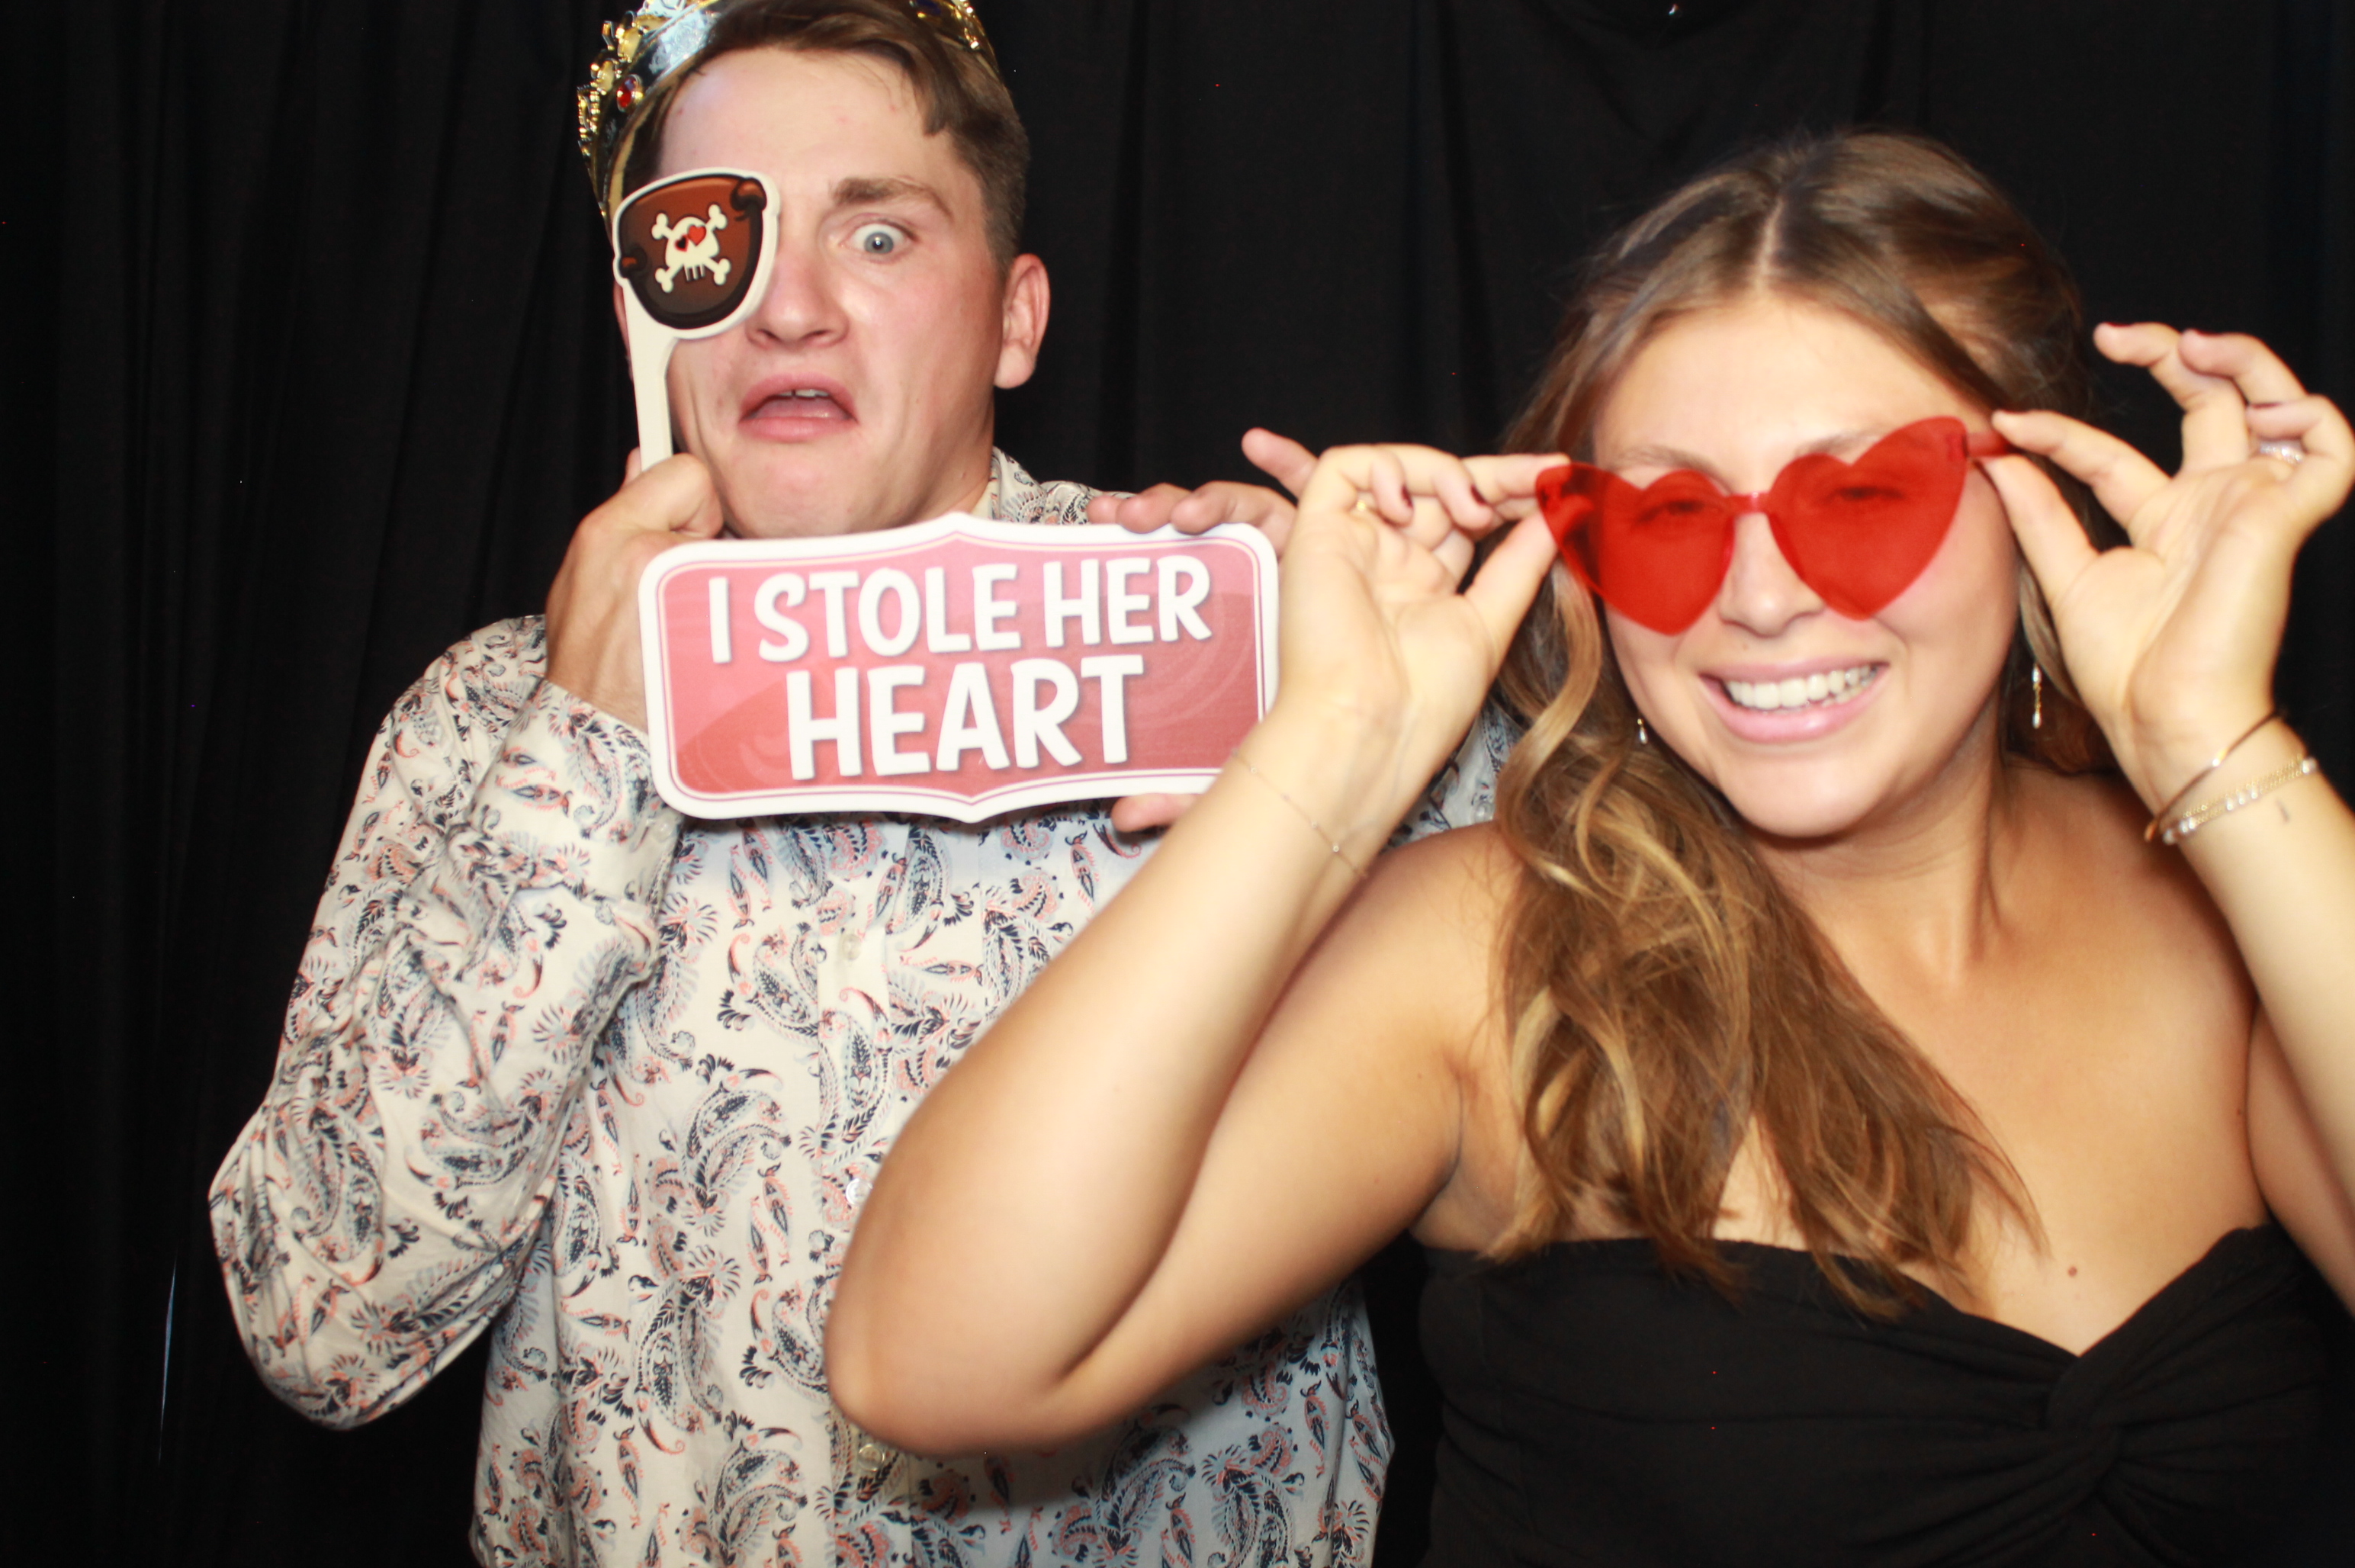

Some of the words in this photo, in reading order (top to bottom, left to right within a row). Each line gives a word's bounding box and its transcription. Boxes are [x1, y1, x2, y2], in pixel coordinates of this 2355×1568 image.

[707, 575, 732, 664] I
[753, 564, 1024, 663] STOLE
[1042, 554, 1213, 648] HER
[786, 654, 1145, 780] HEART
